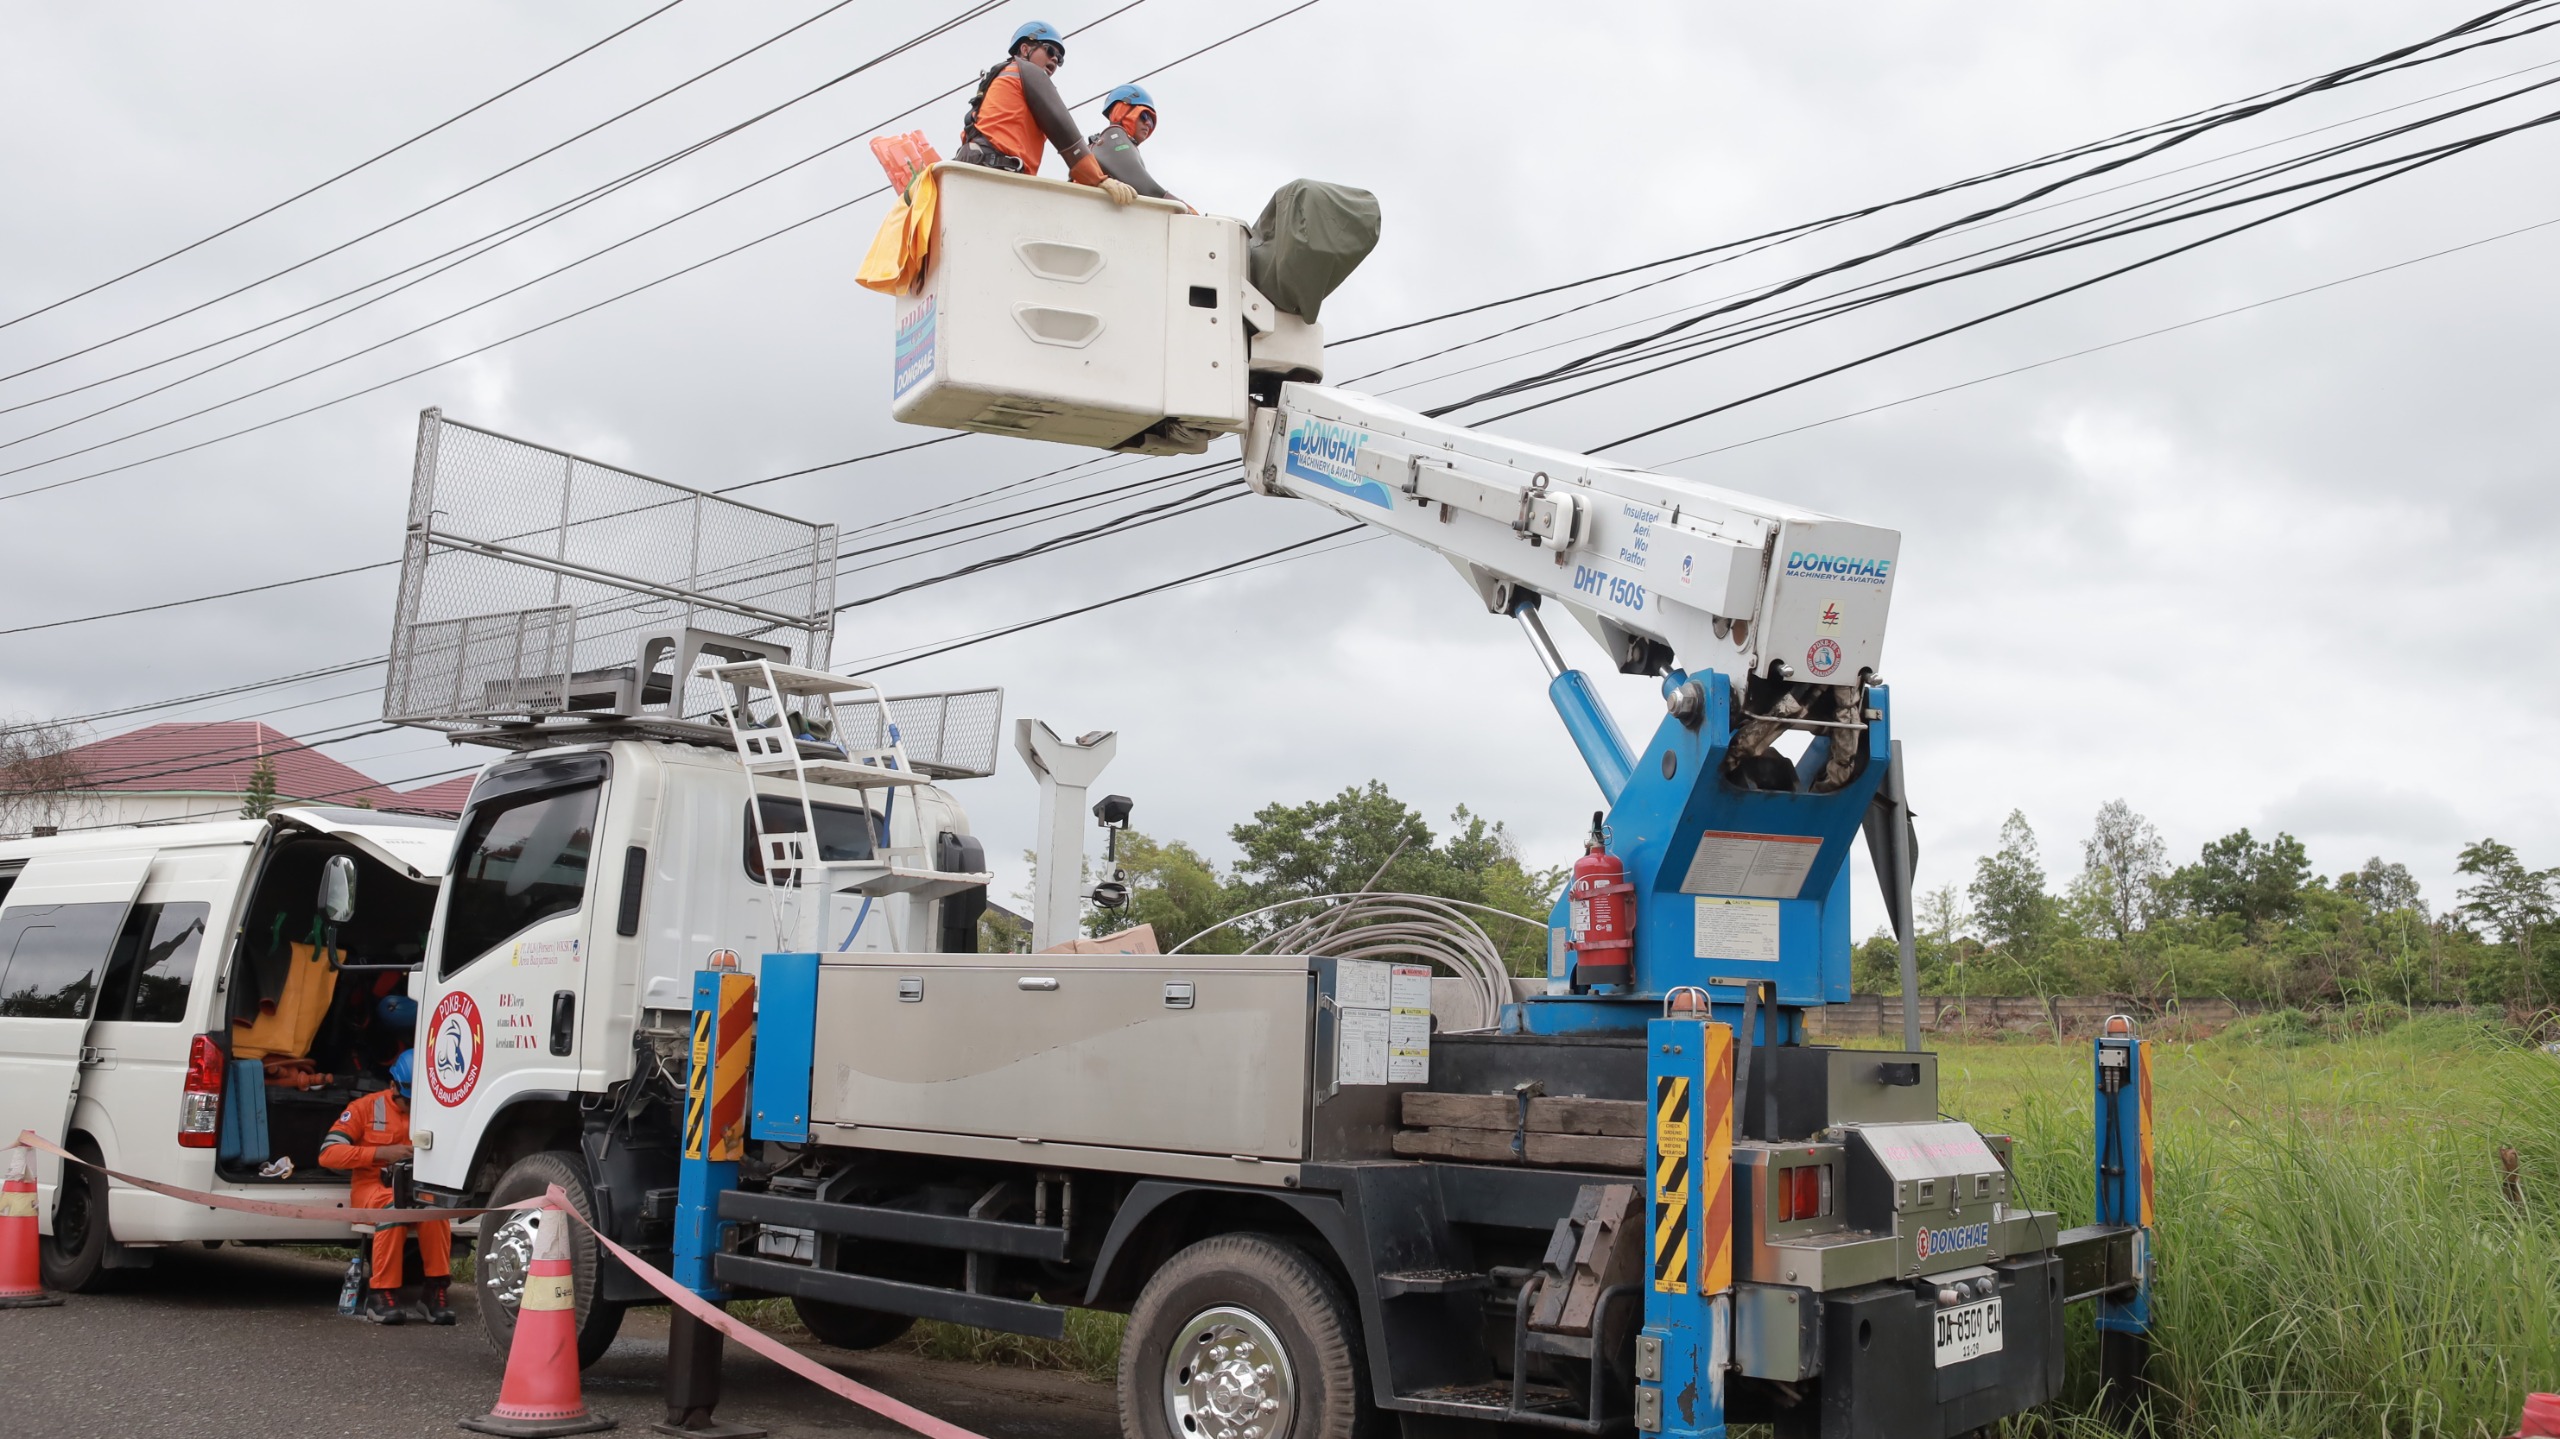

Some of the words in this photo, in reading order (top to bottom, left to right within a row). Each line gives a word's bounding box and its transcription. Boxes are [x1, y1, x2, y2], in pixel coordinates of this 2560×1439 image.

[897, 349, 934, 392] DONGHAE
[1299, 453, 1330, 473] MACHINERY
[1330, 465, 1335, 475] &
[1335, 467, 1362, 483] AVIATION
[1786, 570, 1838, 581] MACHINERY
[1847, 576, 1885, 585] AVIATION
[1787, 551, 1891, 578] DONGHAE
[1574, 565, 1607, 596] DHT
[1609, 576, 1646, 611] 150S
[439, 995, 473, 1020] PDKB-TM
[428, 1067, 439, 1095] AREA
[438, 1064, 479, 1104] BANJARMASIN
[1929, 1223, 1989, 1254] DONGHAE
[1937, 1314, 1953, 1347] DA
[1957, 1307, 1982, 1342] 8509
